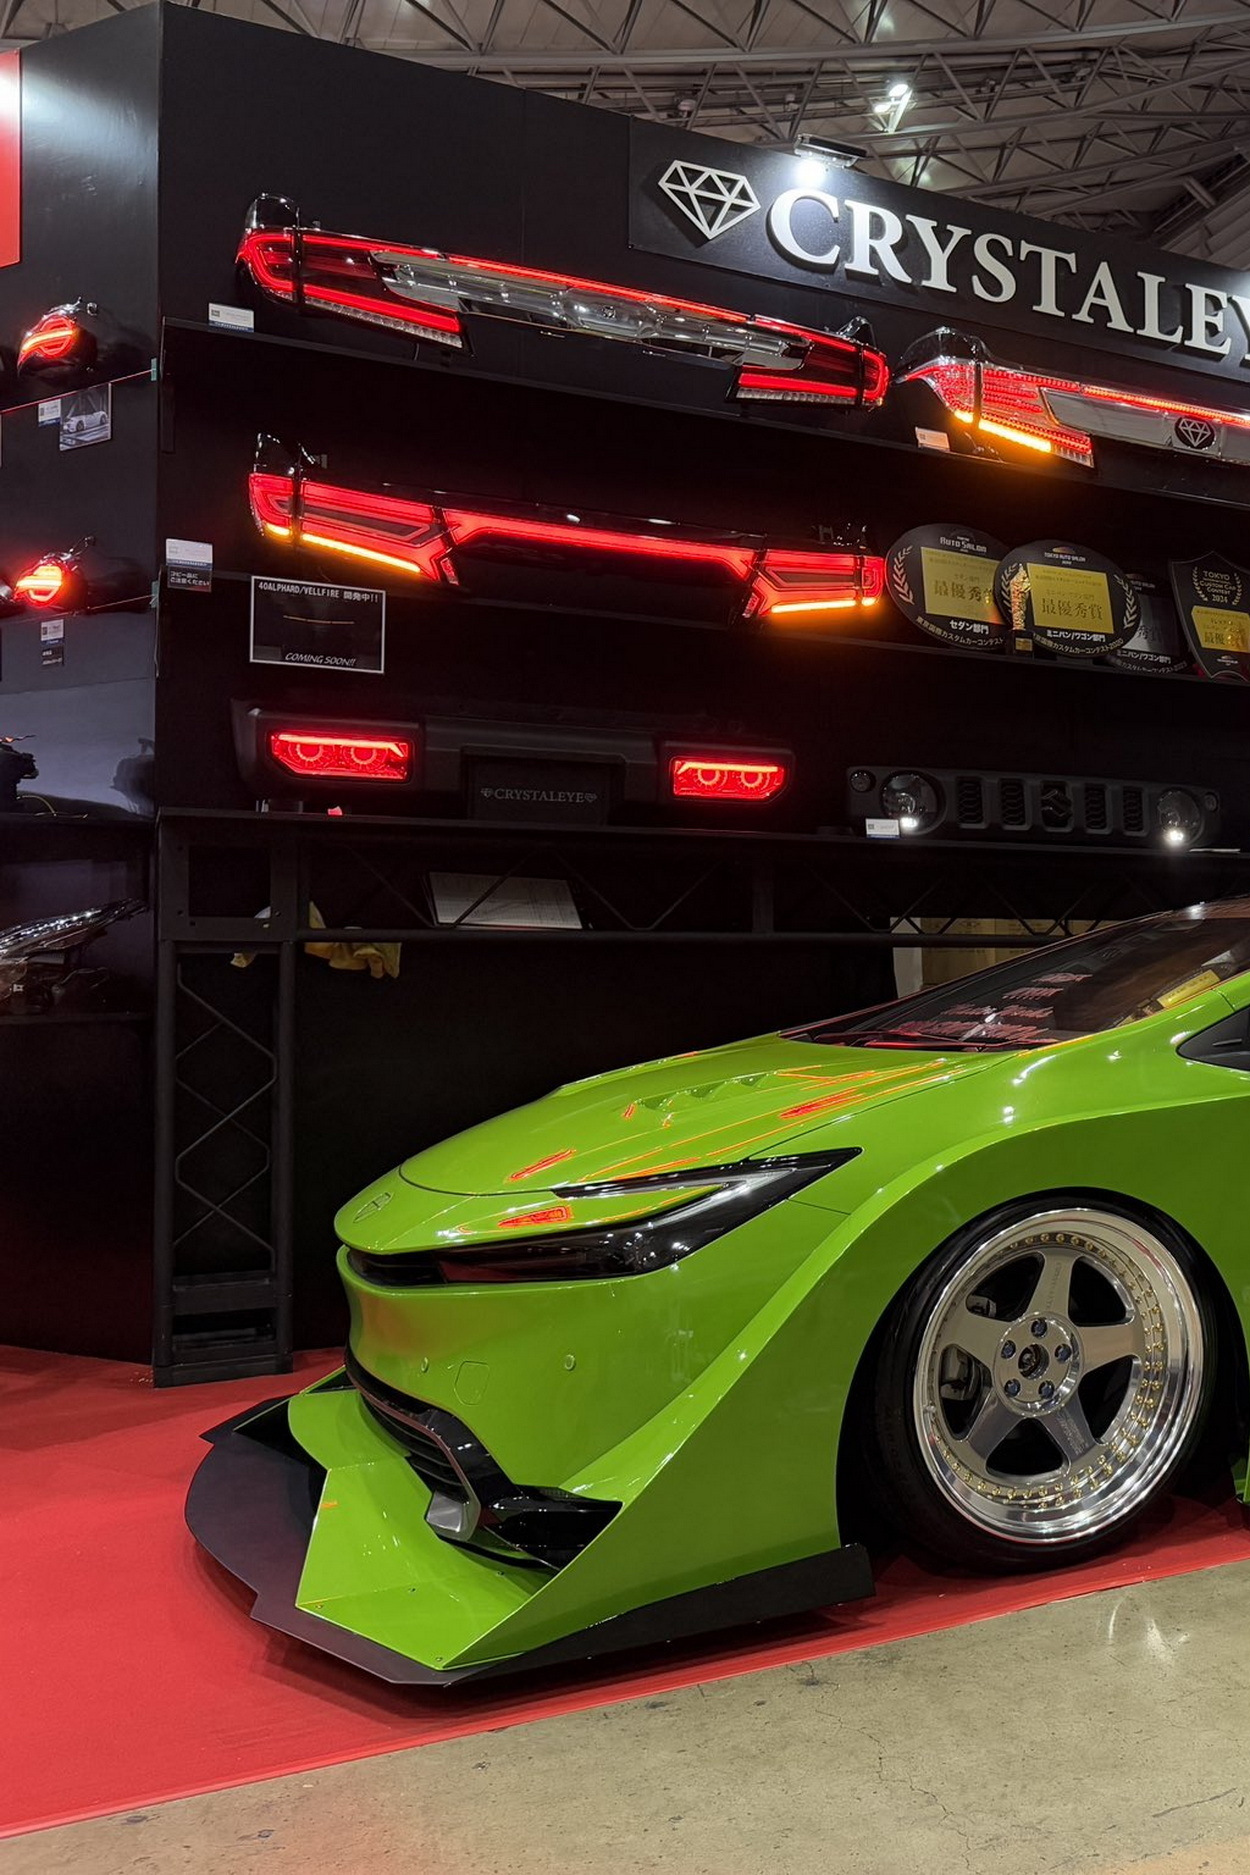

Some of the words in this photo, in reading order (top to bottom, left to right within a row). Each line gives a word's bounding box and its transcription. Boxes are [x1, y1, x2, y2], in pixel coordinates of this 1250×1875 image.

[1203, 571, 1230, 581] TOKYO
[950, 620, 989, 635] セダン部門
[285, 652, 324, 664] COMING
[324, 656, 356, 667] SOON!!
[494, 788, 584, 803] CRYSTALEYE
